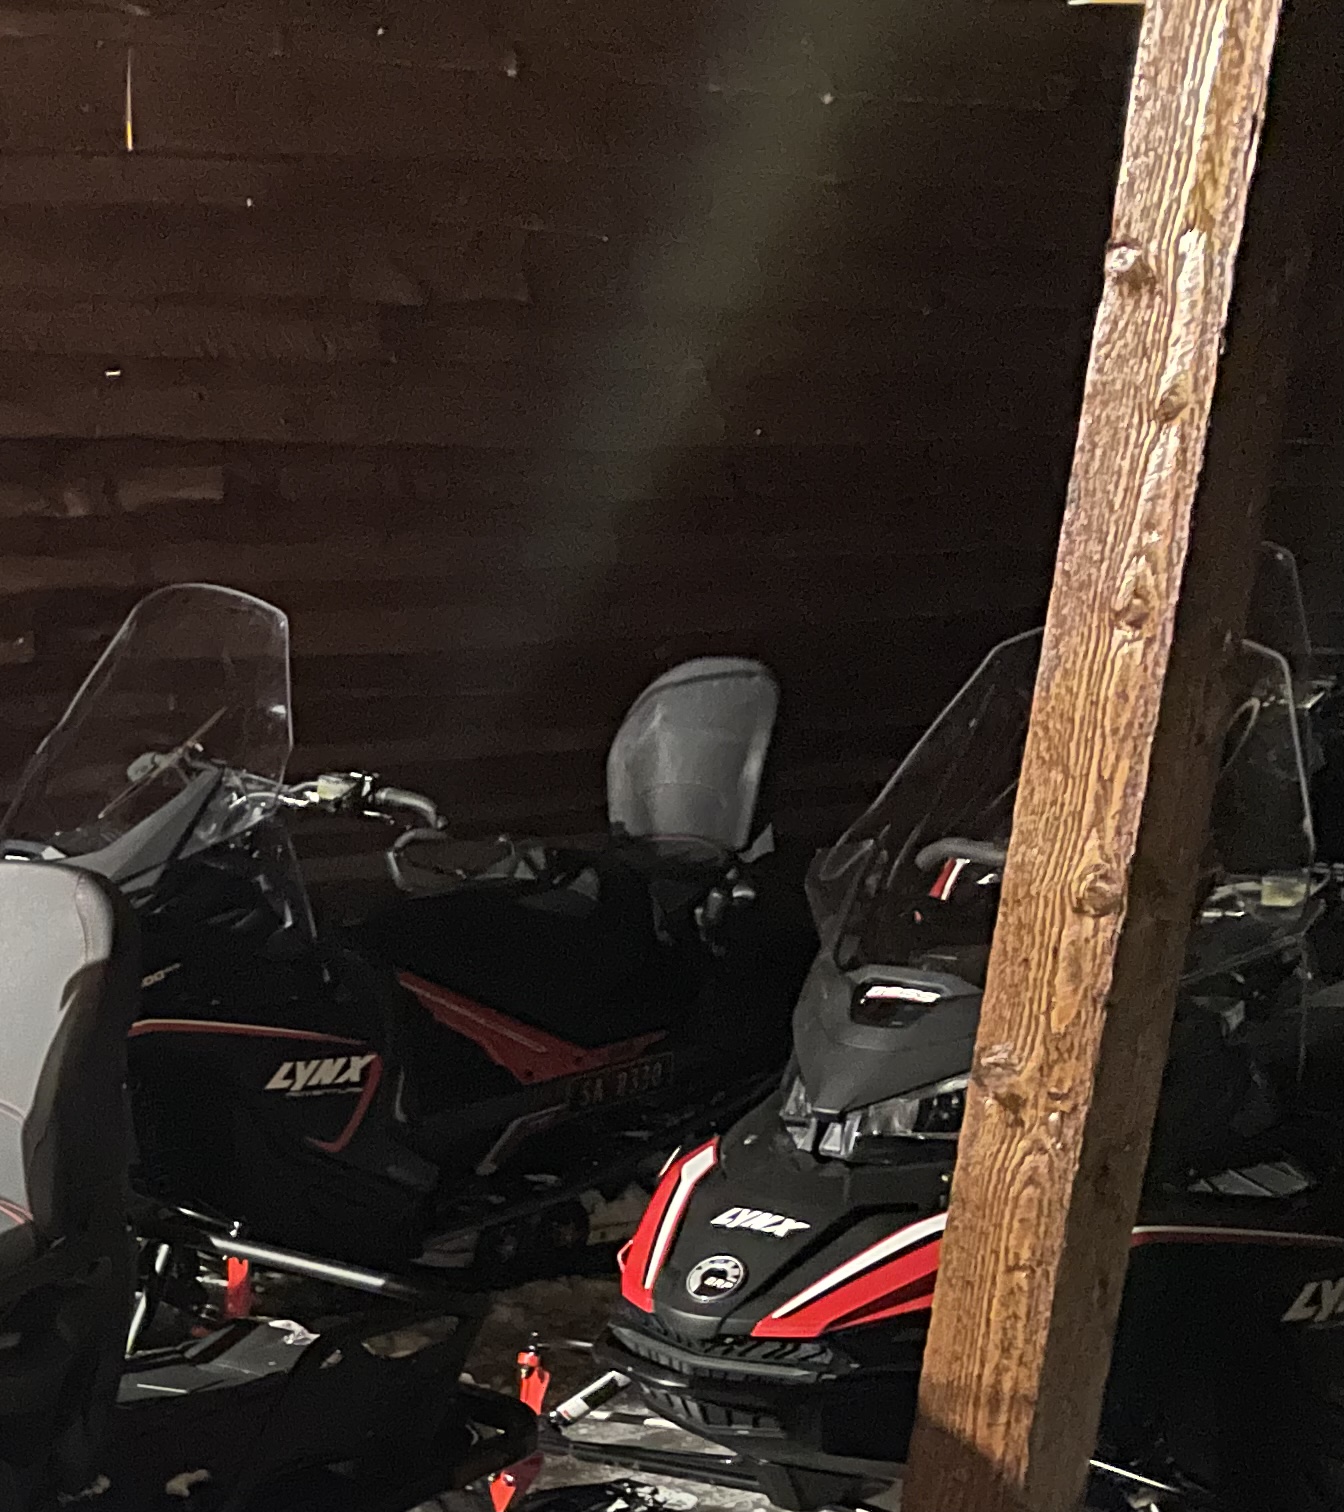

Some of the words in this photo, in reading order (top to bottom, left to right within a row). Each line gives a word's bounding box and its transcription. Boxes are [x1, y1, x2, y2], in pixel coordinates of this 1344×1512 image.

[264, 1053, 378, 1091] LYNX
[710, 1206, 811, 1238] LYNX
[1280, 1276, 1344, 1323] LY
